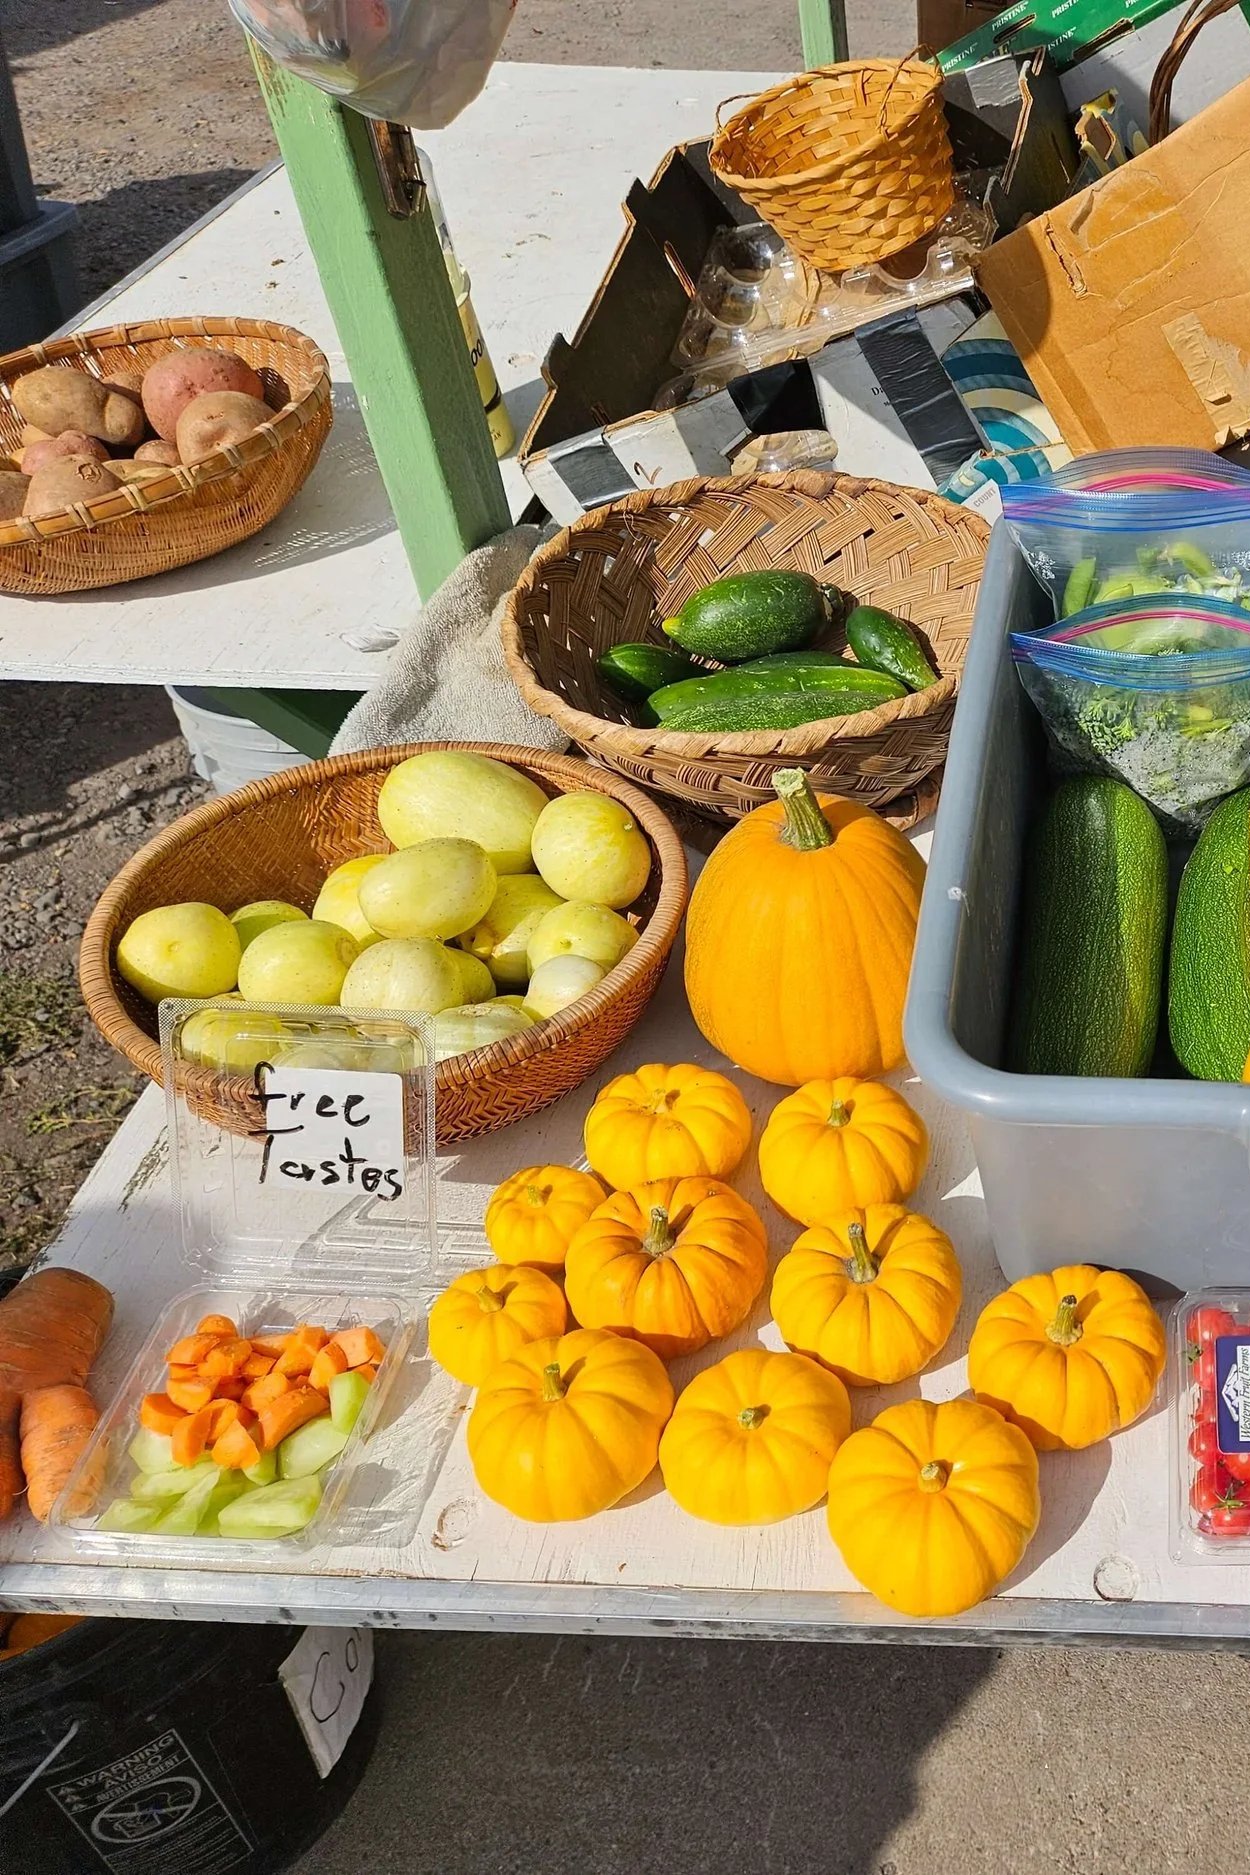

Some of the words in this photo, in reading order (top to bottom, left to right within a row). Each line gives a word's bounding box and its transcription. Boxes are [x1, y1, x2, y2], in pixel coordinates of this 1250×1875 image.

[973, 487, 997, 508] COUNT
[1238, 1347, 1250, 1377] Farms
[77, 1734, 174, 1787] WARNING
[105, 1754, 163, 1789] AVISO
